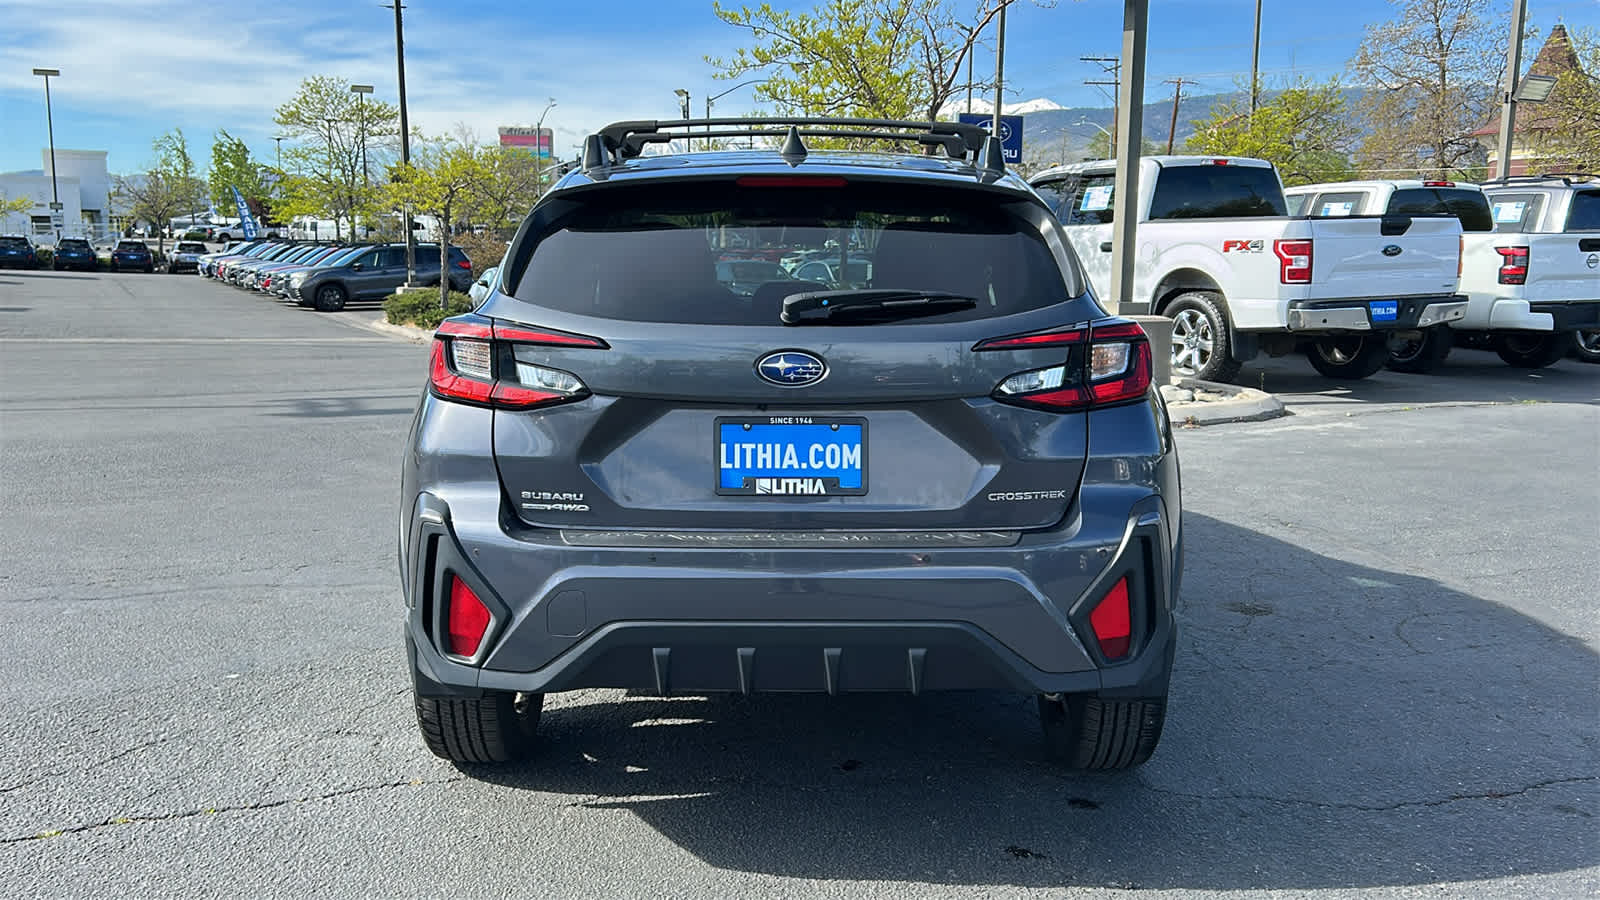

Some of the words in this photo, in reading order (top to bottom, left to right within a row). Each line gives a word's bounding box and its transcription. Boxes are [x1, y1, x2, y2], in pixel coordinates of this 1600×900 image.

[1223, 239, 1264, 253] FX4
[720, 443, 861, 469] LITHIA.COM
[772, 478, 826, 494] LITHIA
[521, 491, 584, 501] SUBARU
[988, 490, 1066, 501] CROSSTREK
